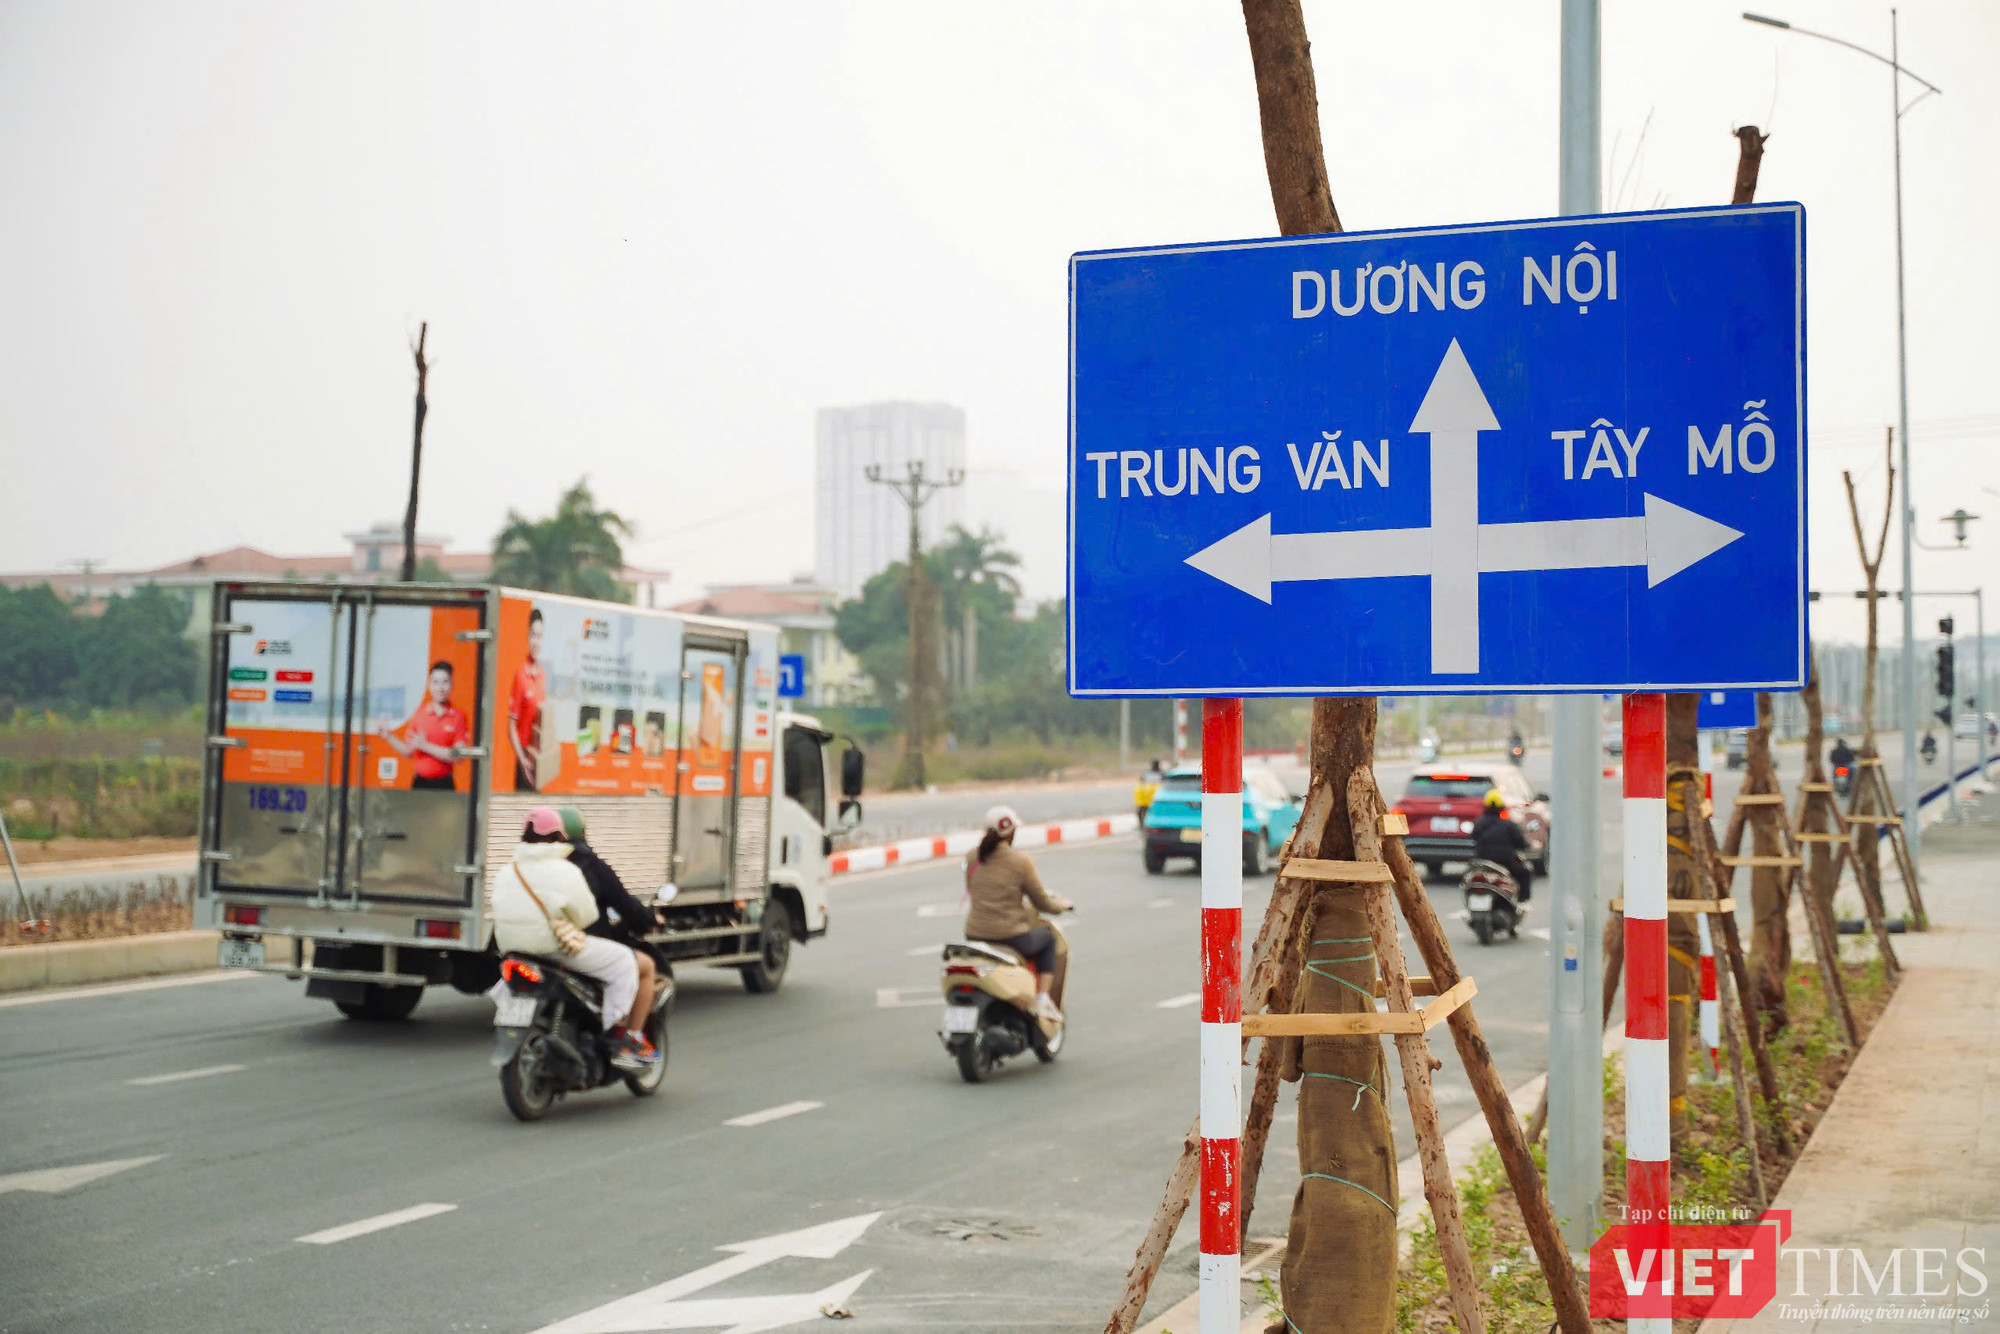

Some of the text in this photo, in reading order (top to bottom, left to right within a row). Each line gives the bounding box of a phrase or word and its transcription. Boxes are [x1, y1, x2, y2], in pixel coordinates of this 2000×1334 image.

[1293, 242, 1616, 318] DƯƠNG NỘI
[1086, 431, 1389, 498] TRUNG VĂN
[1552, 400, 1775, 480] TÂY MỖ
